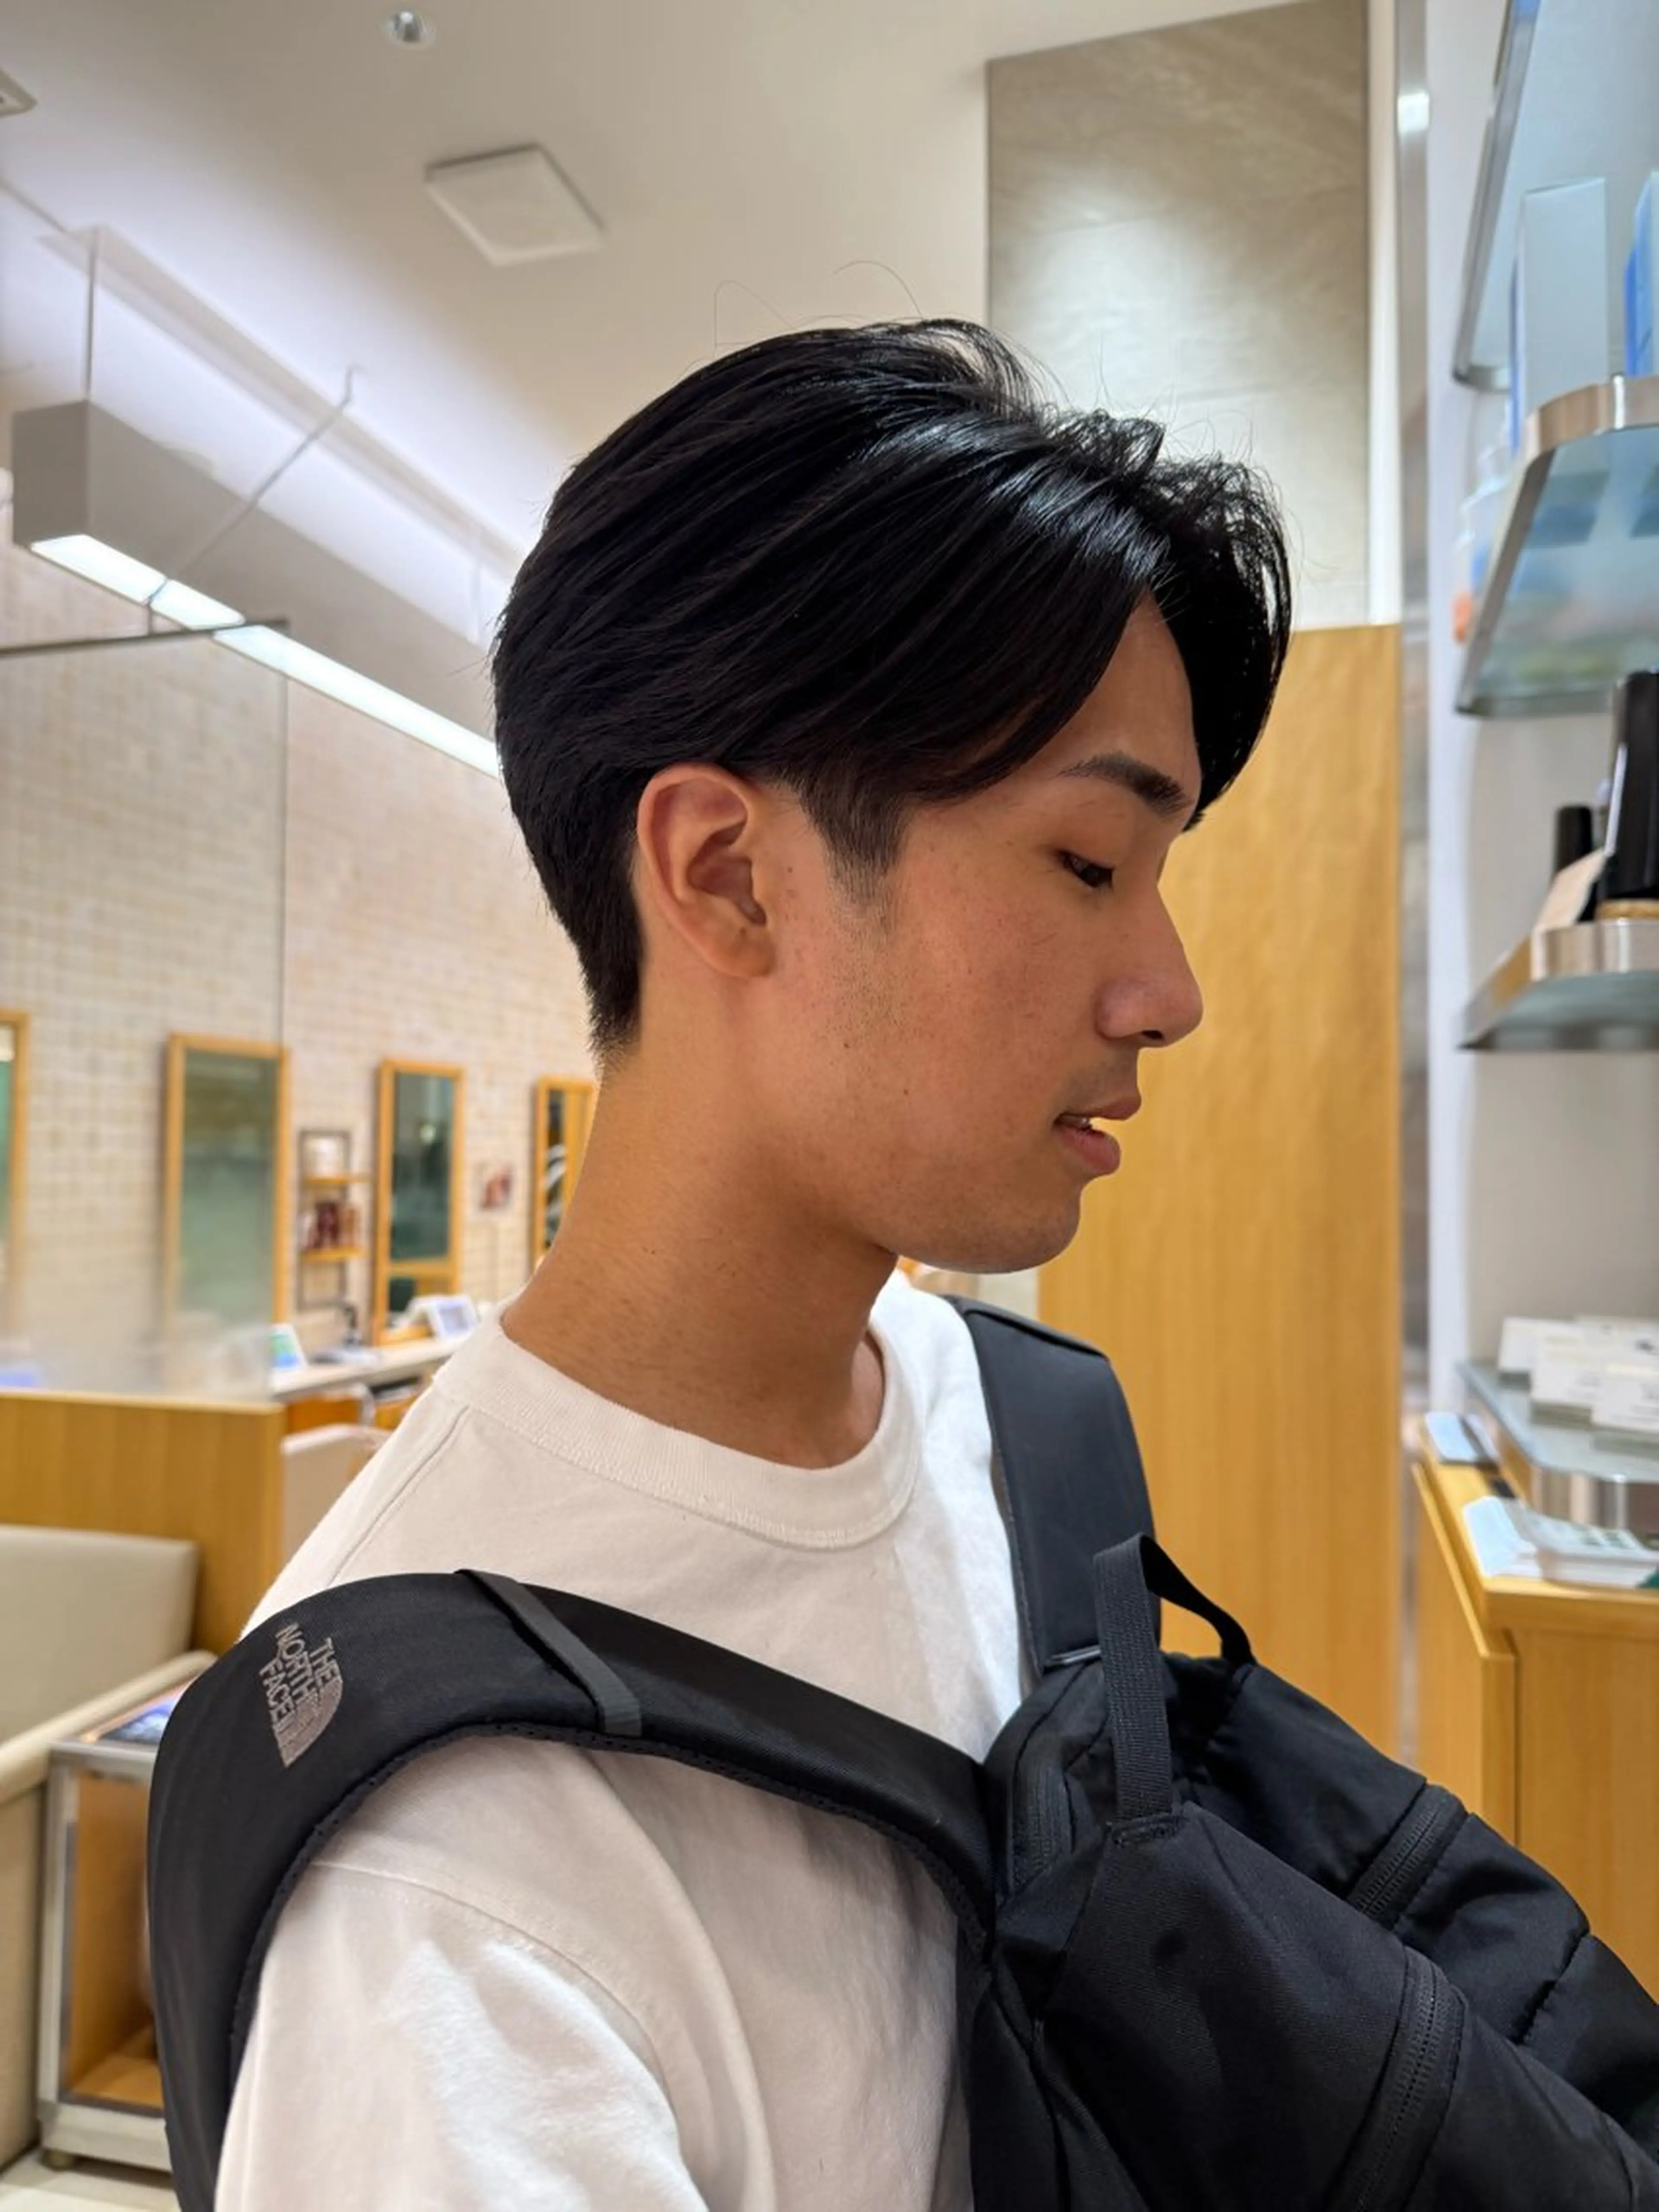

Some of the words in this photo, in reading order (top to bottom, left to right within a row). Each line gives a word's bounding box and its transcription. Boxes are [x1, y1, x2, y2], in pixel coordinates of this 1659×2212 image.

[259, 1658, 295, 1724] FACE
[275, 1622, 317, 1705] NORTH
[309, 1637, 342, 1688] THE
